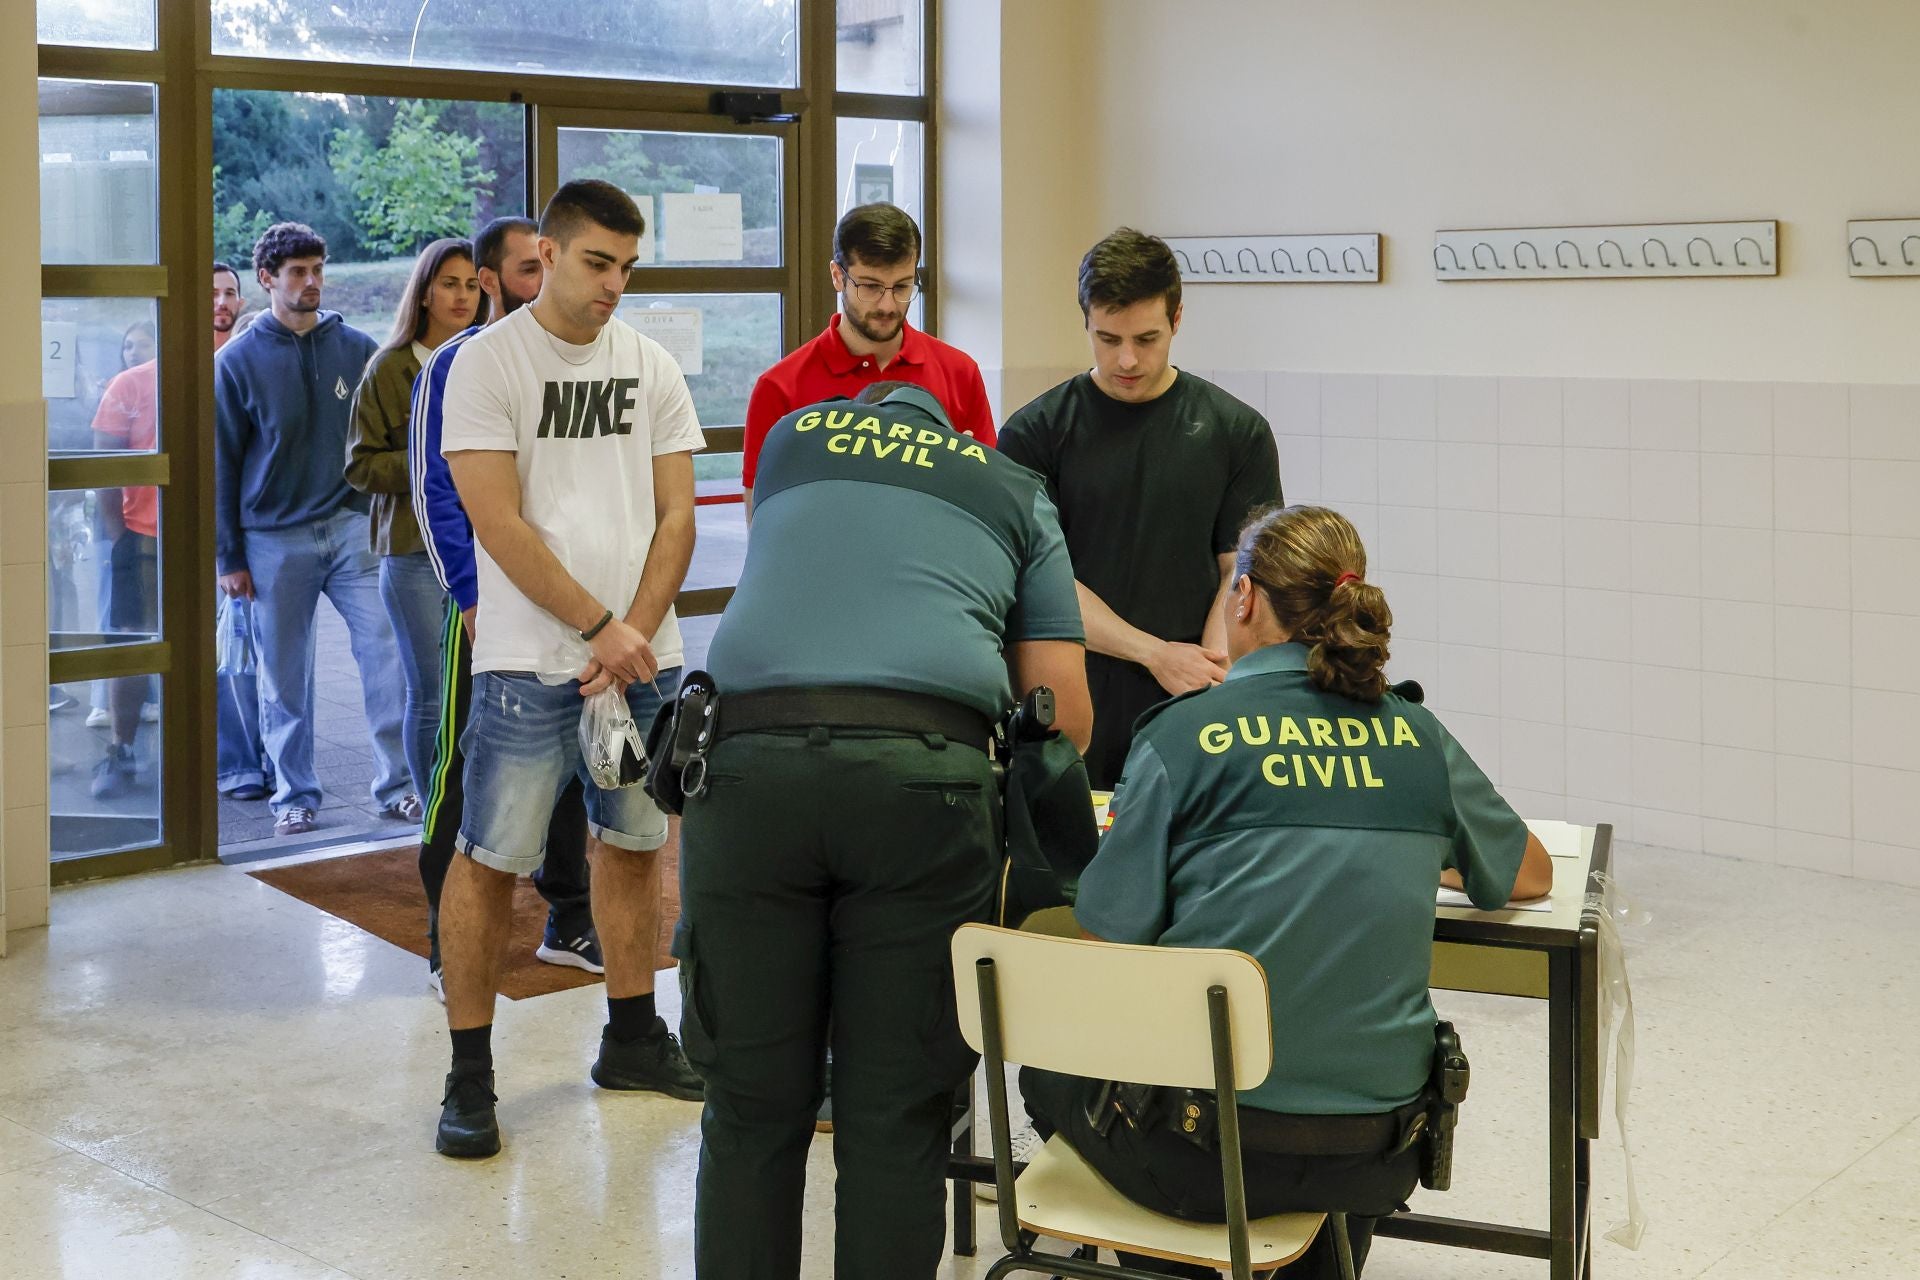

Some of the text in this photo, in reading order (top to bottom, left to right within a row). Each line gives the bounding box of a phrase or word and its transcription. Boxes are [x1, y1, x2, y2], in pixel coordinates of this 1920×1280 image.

[50, 340, 62, 360] 2
[537, 377, 640, 439] NIKE
[795, 410, 988, 465] GUARDIA
[827, 434, 935, 467] CIVIL
[1199, 717, 1420, 754] GUARDIA
[1261, 754, 1384, 788] CIVIL
